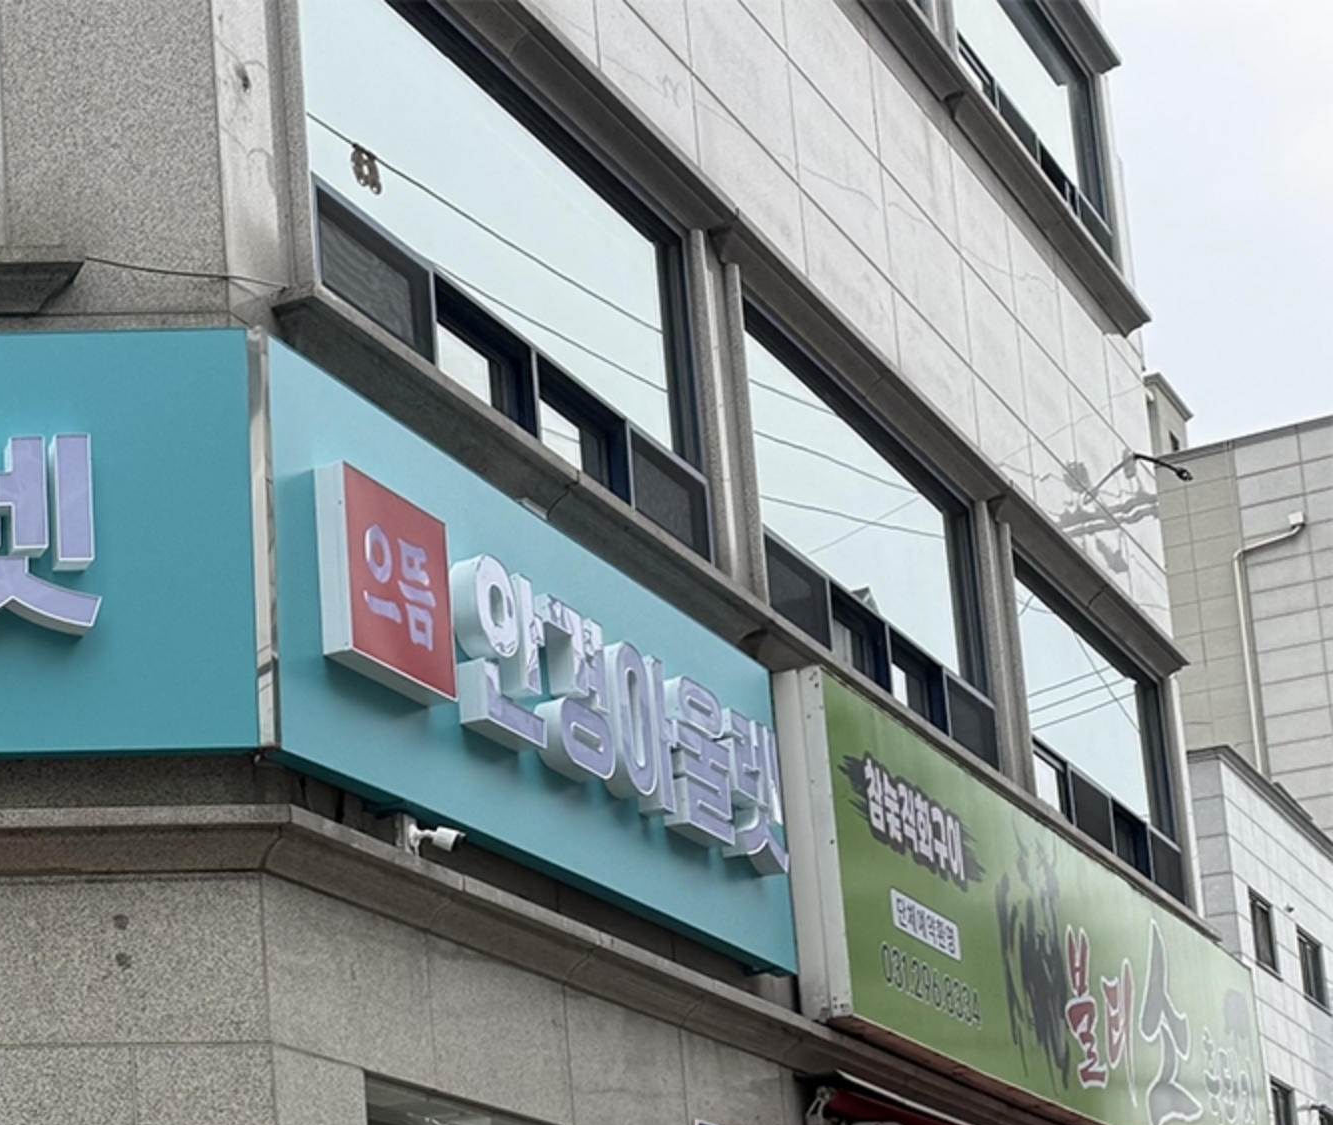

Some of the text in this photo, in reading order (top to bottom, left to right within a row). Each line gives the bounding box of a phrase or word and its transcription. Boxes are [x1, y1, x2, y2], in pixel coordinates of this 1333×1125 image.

[364, 523, 789, 874] 으뜸 안경아울렛
[881, 941, 982, 1030] 031.296.8334
